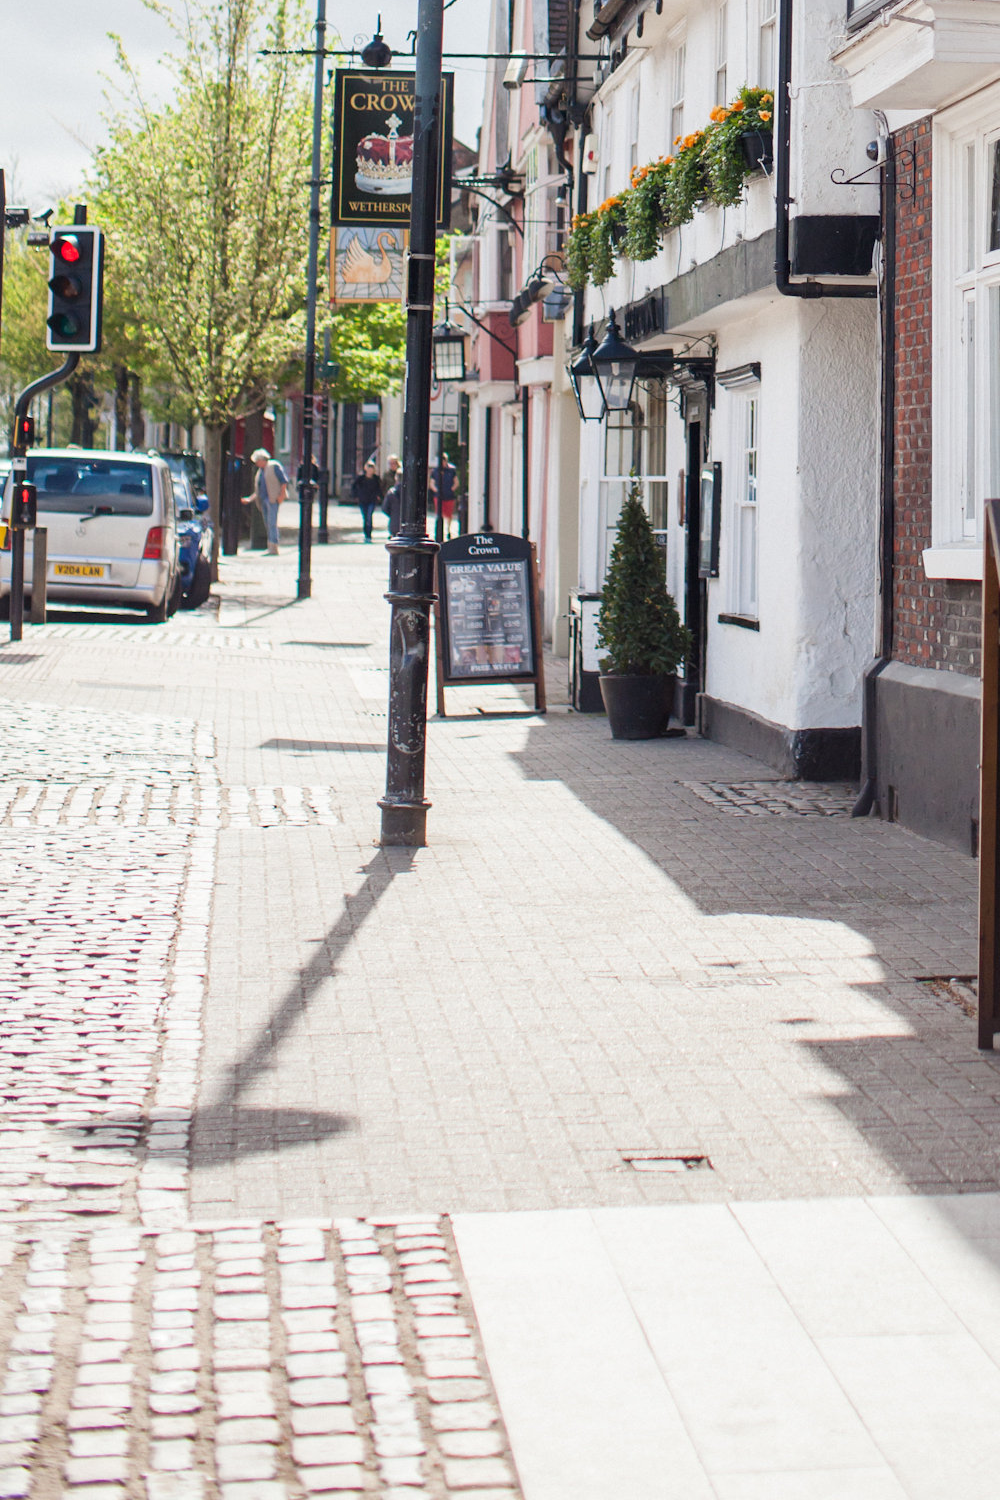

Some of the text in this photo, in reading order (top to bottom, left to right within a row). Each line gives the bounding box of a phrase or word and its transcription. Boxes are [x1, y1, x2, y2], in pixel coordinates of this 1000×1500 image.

[381, 80, 409, 92] THE
[350, 92, 415, 112] CROW
[348, 201, 411, 212] WETHERSP
[474, 535, 494, 545] The
[468, 546, 500, 555] Crown
[82, 565, 101, 576] LAN
[449, 563, 522, 573] GREAT VALUE
